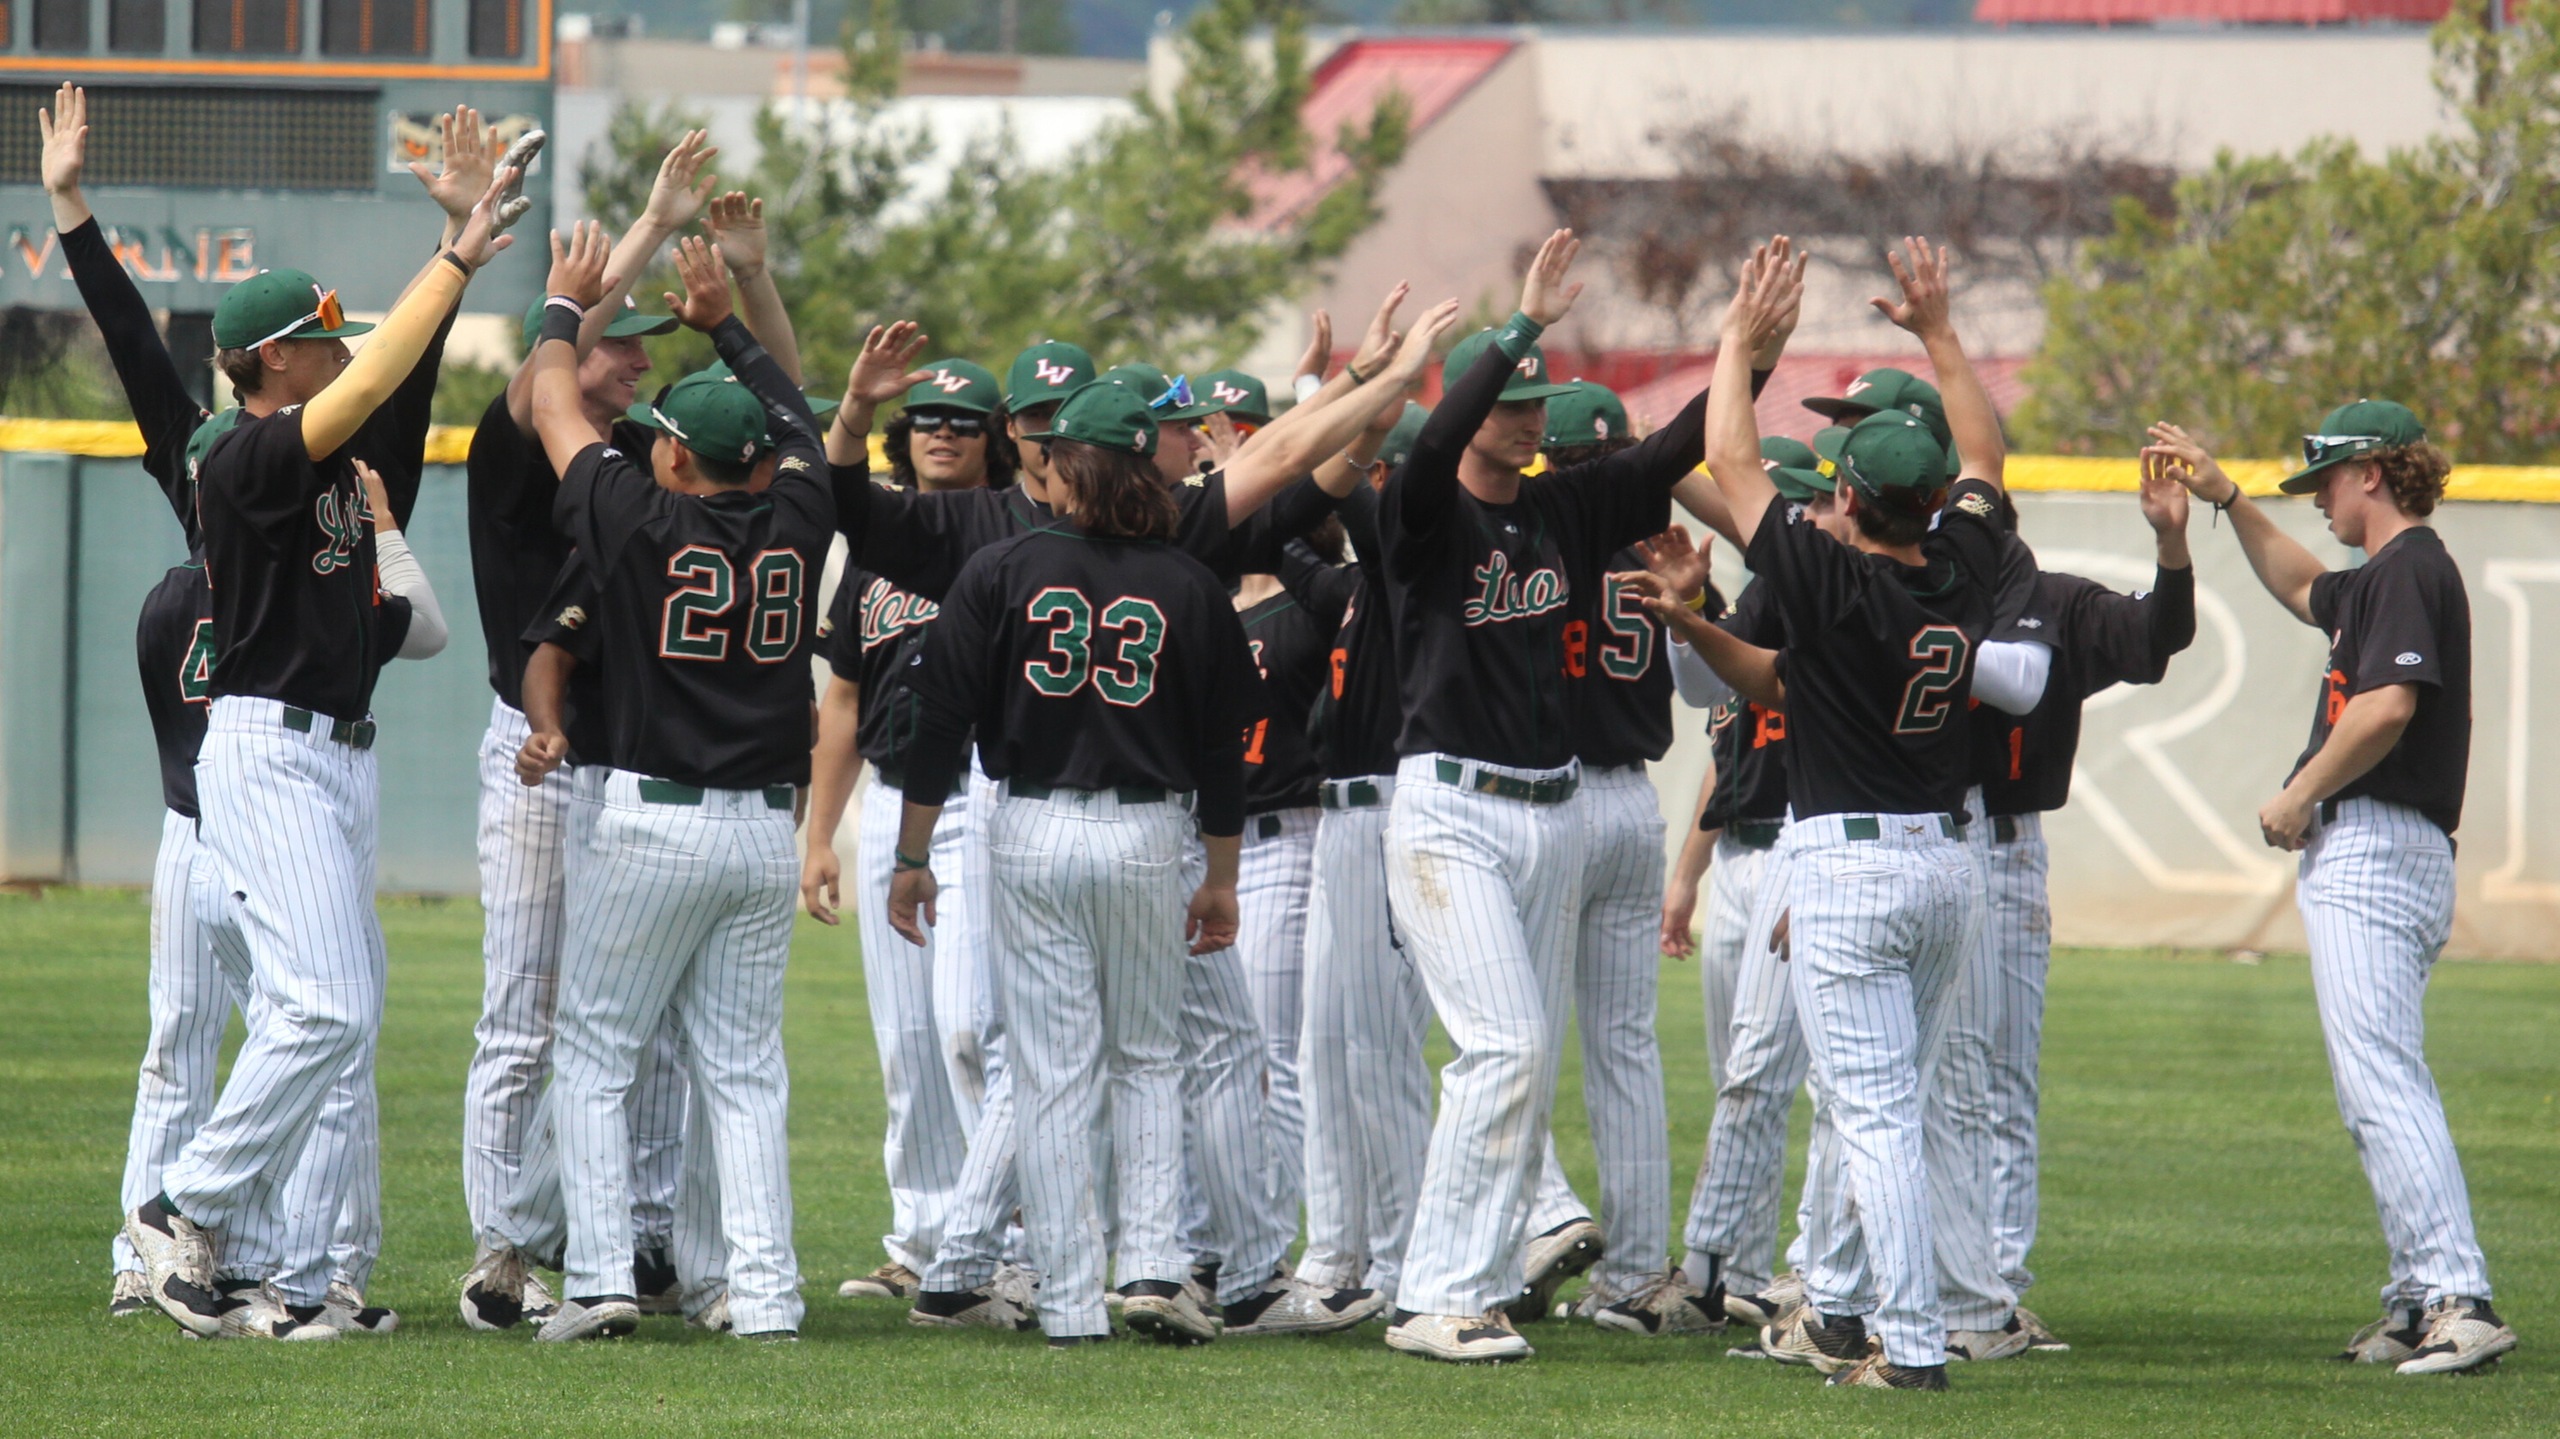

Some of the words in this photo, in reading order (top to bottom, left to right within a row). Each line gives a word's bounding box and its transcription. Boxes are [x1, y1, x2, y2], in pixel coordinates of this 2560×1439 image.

[9, 224, 260, 284] VRNE
[932, 368, 972, 394] LV
[1035, 359, 1074, 386] LV
[1211, 381, 1250, 405] LV
[659, 544, 804, 663] 28
[1600, 571, 1654, 682] 5
[1025, 586, 1167, 707] 33
[1892, 624, 1971, 735] 2
